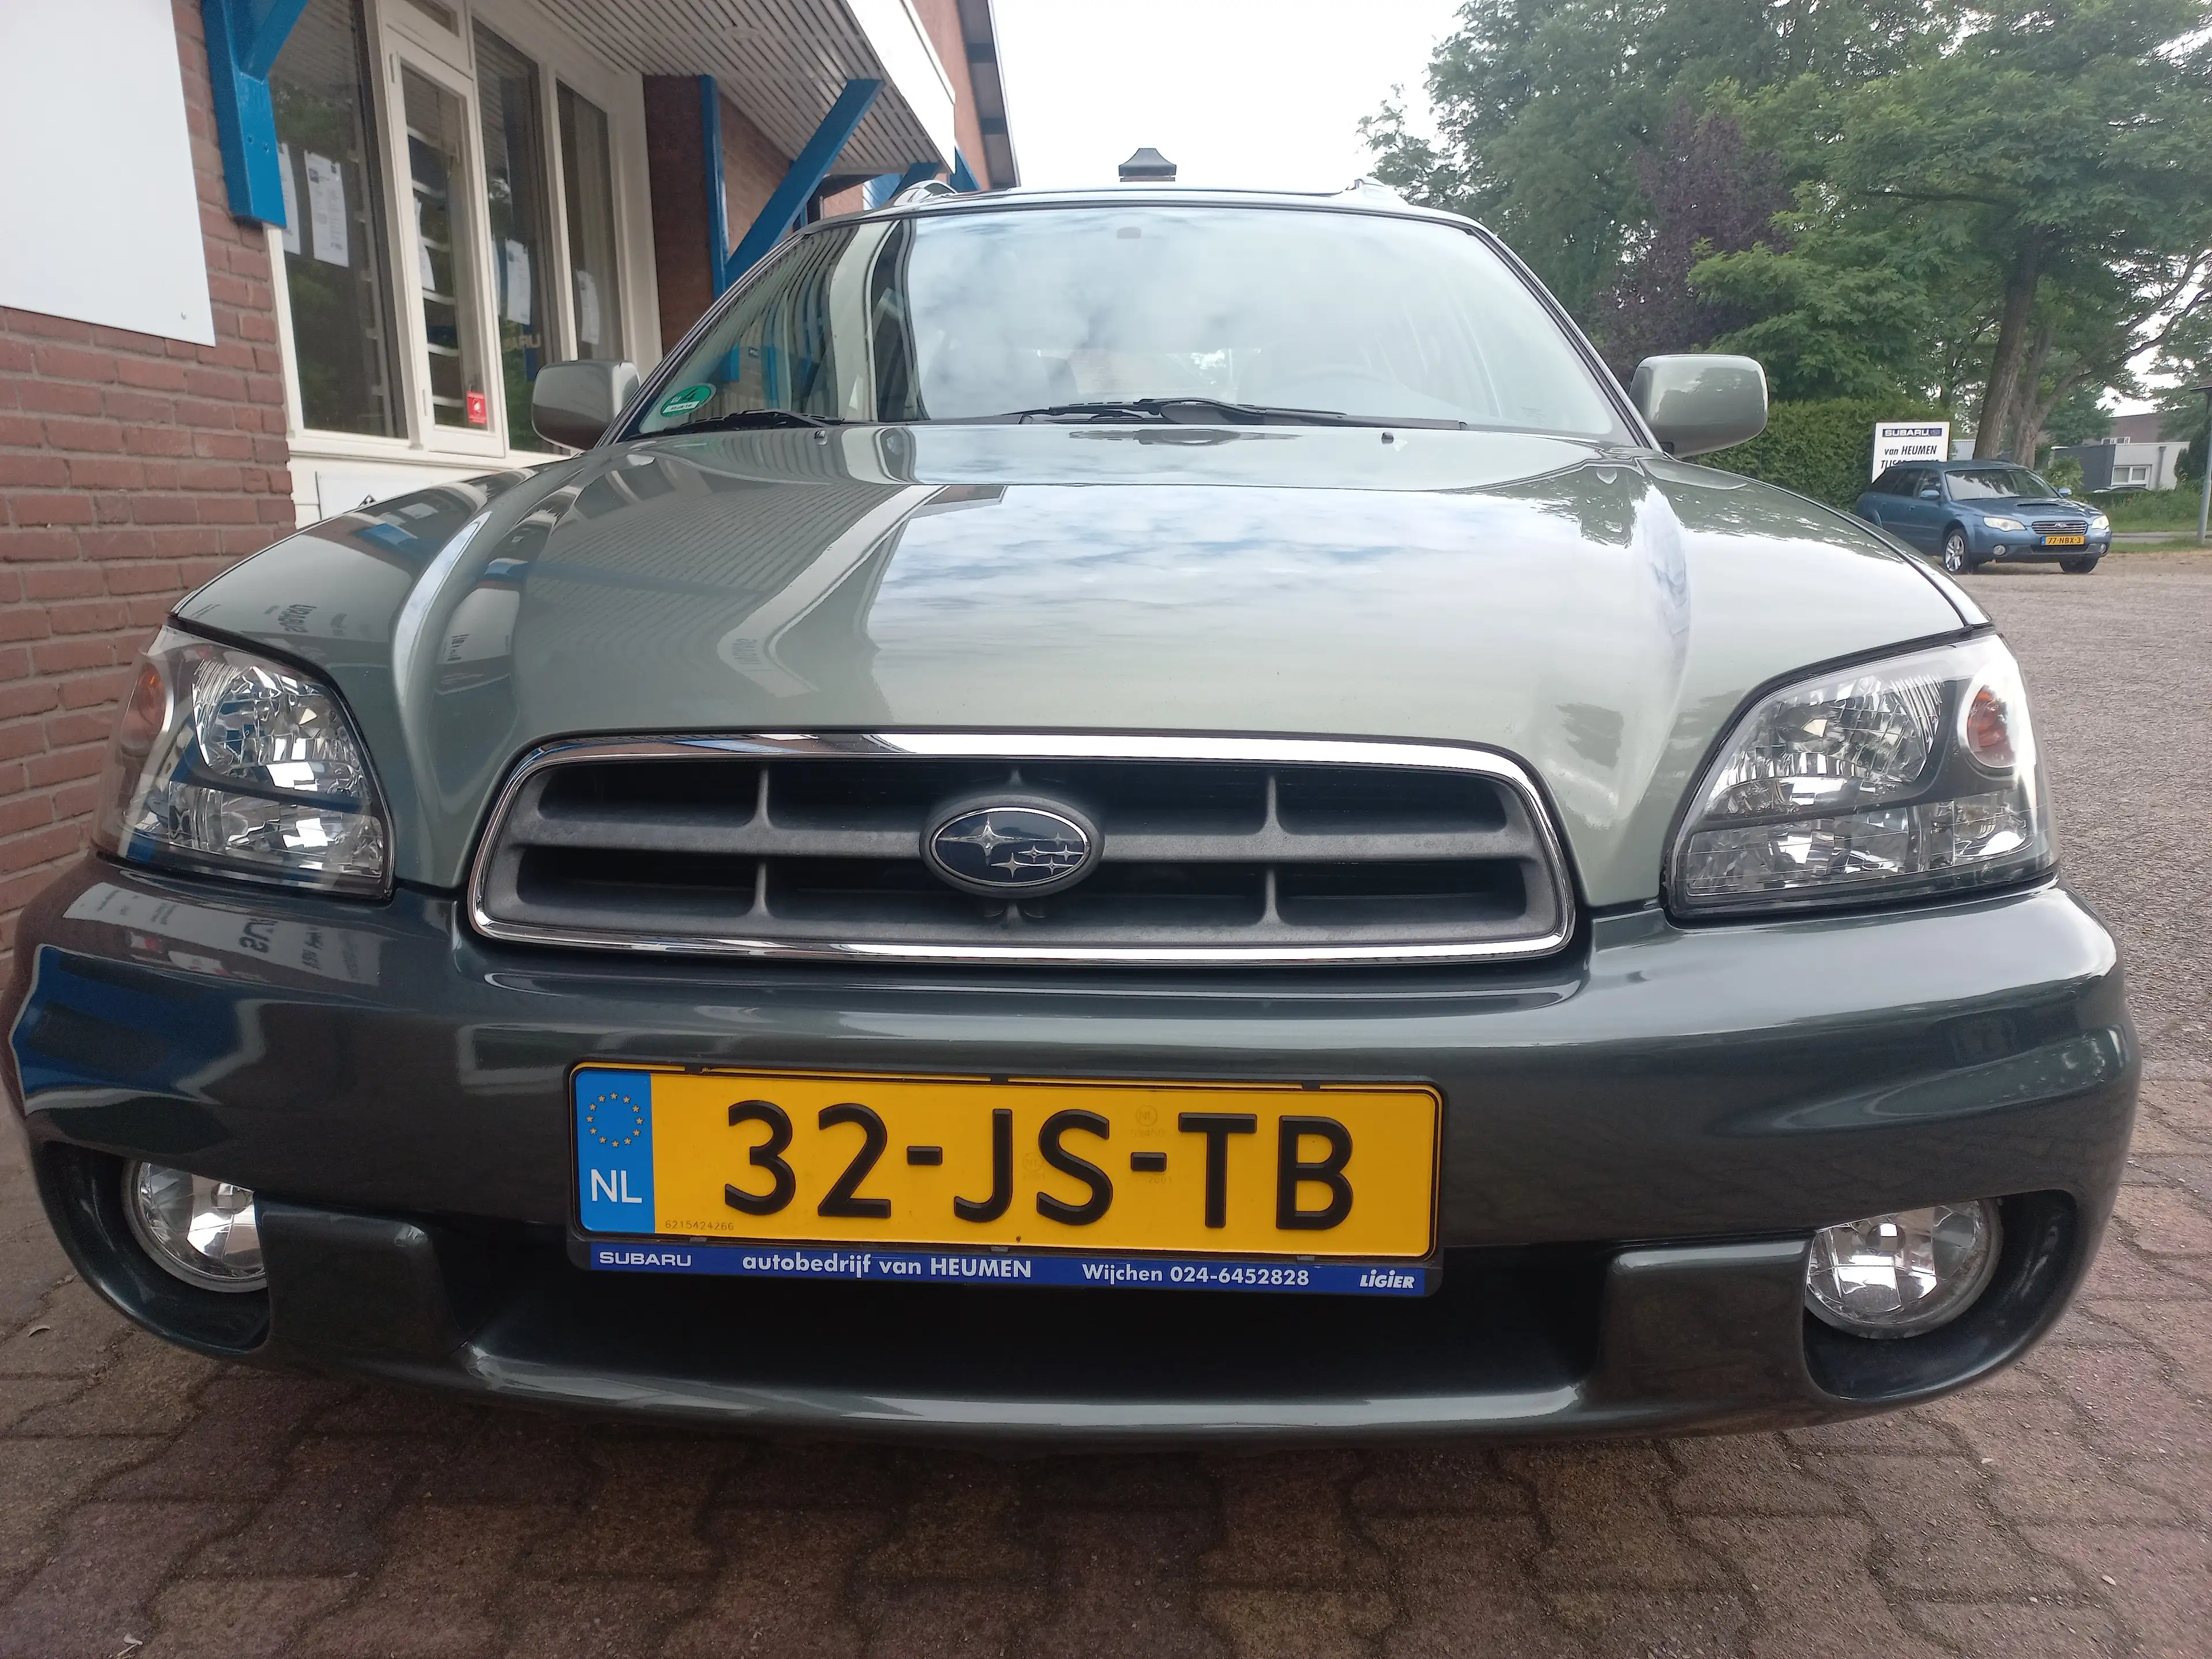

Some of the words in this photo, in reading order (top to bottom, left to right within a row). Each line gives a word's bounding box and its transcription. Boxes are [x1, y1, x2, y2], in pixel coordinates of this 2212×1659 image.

[1884, 429, 1929, 437] SUBARU
[1901, 445, 1937, 455] HEUMEN
[724, 1100, 1354, 1230] 32-JS-TB
[590, 1168, 643, 1204] NL
[665, 1219, 734, 1231] 6215424266
[599, 1251, 691, 1267] SUBARU
[742, 1251, 871, 1278] autobedrijf
[878, 1260, 921, 1275] van
[930, 1257, 1031, 1278] HEUMEN
[1082, 1263, 1162, 1285] Wijchen
[1169, 1266, 1309, 1286] 024-6452828
